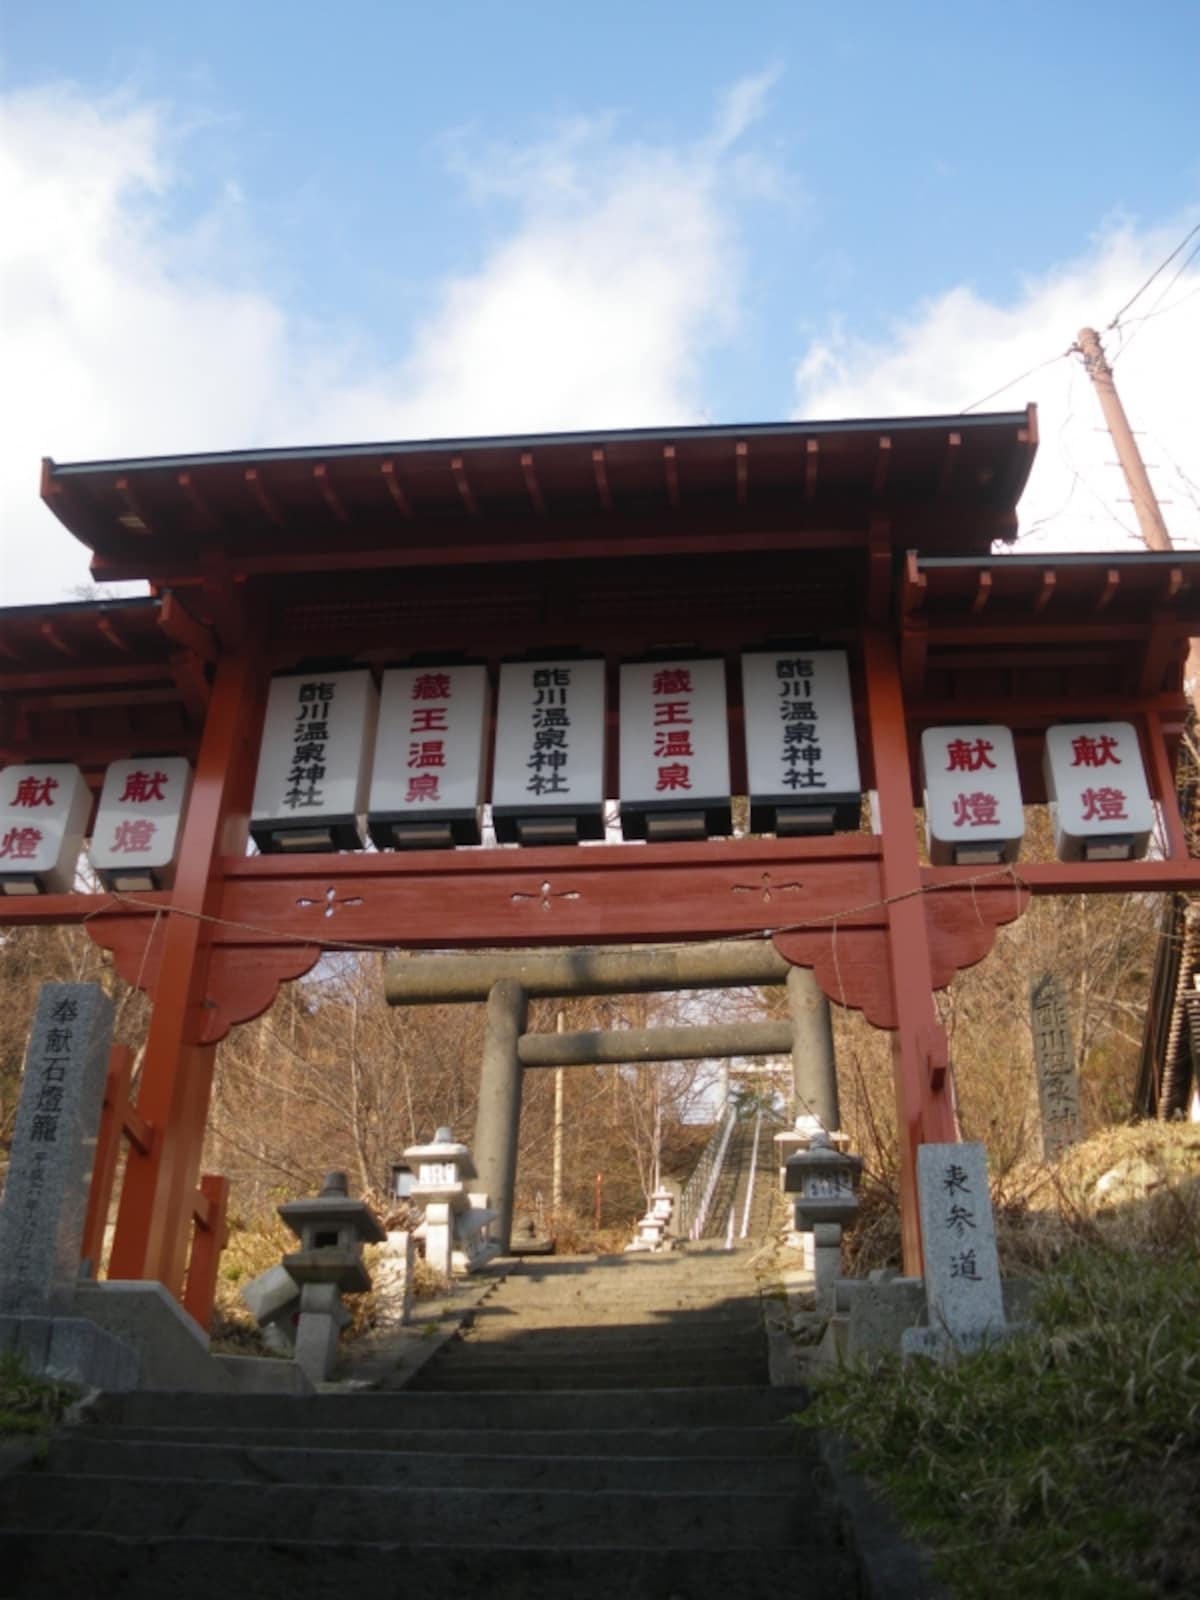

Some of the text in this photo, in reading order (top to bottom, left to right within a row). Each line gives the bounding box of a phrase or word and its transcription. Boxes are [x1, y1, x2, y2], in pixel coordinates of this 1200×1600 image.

[283, 682, 335, 809] 酢川温泉神社
[405, 673, 453, 803] 蔵王温泉
[526, 668, 571, 796] 酢川温泉神社
[653, 669, 694, 791] 蔵王温泉
[776, 658, 827, 789] 酢川温泉神社
[946, 738, 1000, 827] 献燈
[1070, 735, 1128, 821] 献燈
[0, 776, 59, 859] 献燈
[110, 770, 168, 853] 献燈
[943, 1164, 983, 1281] 表参道
